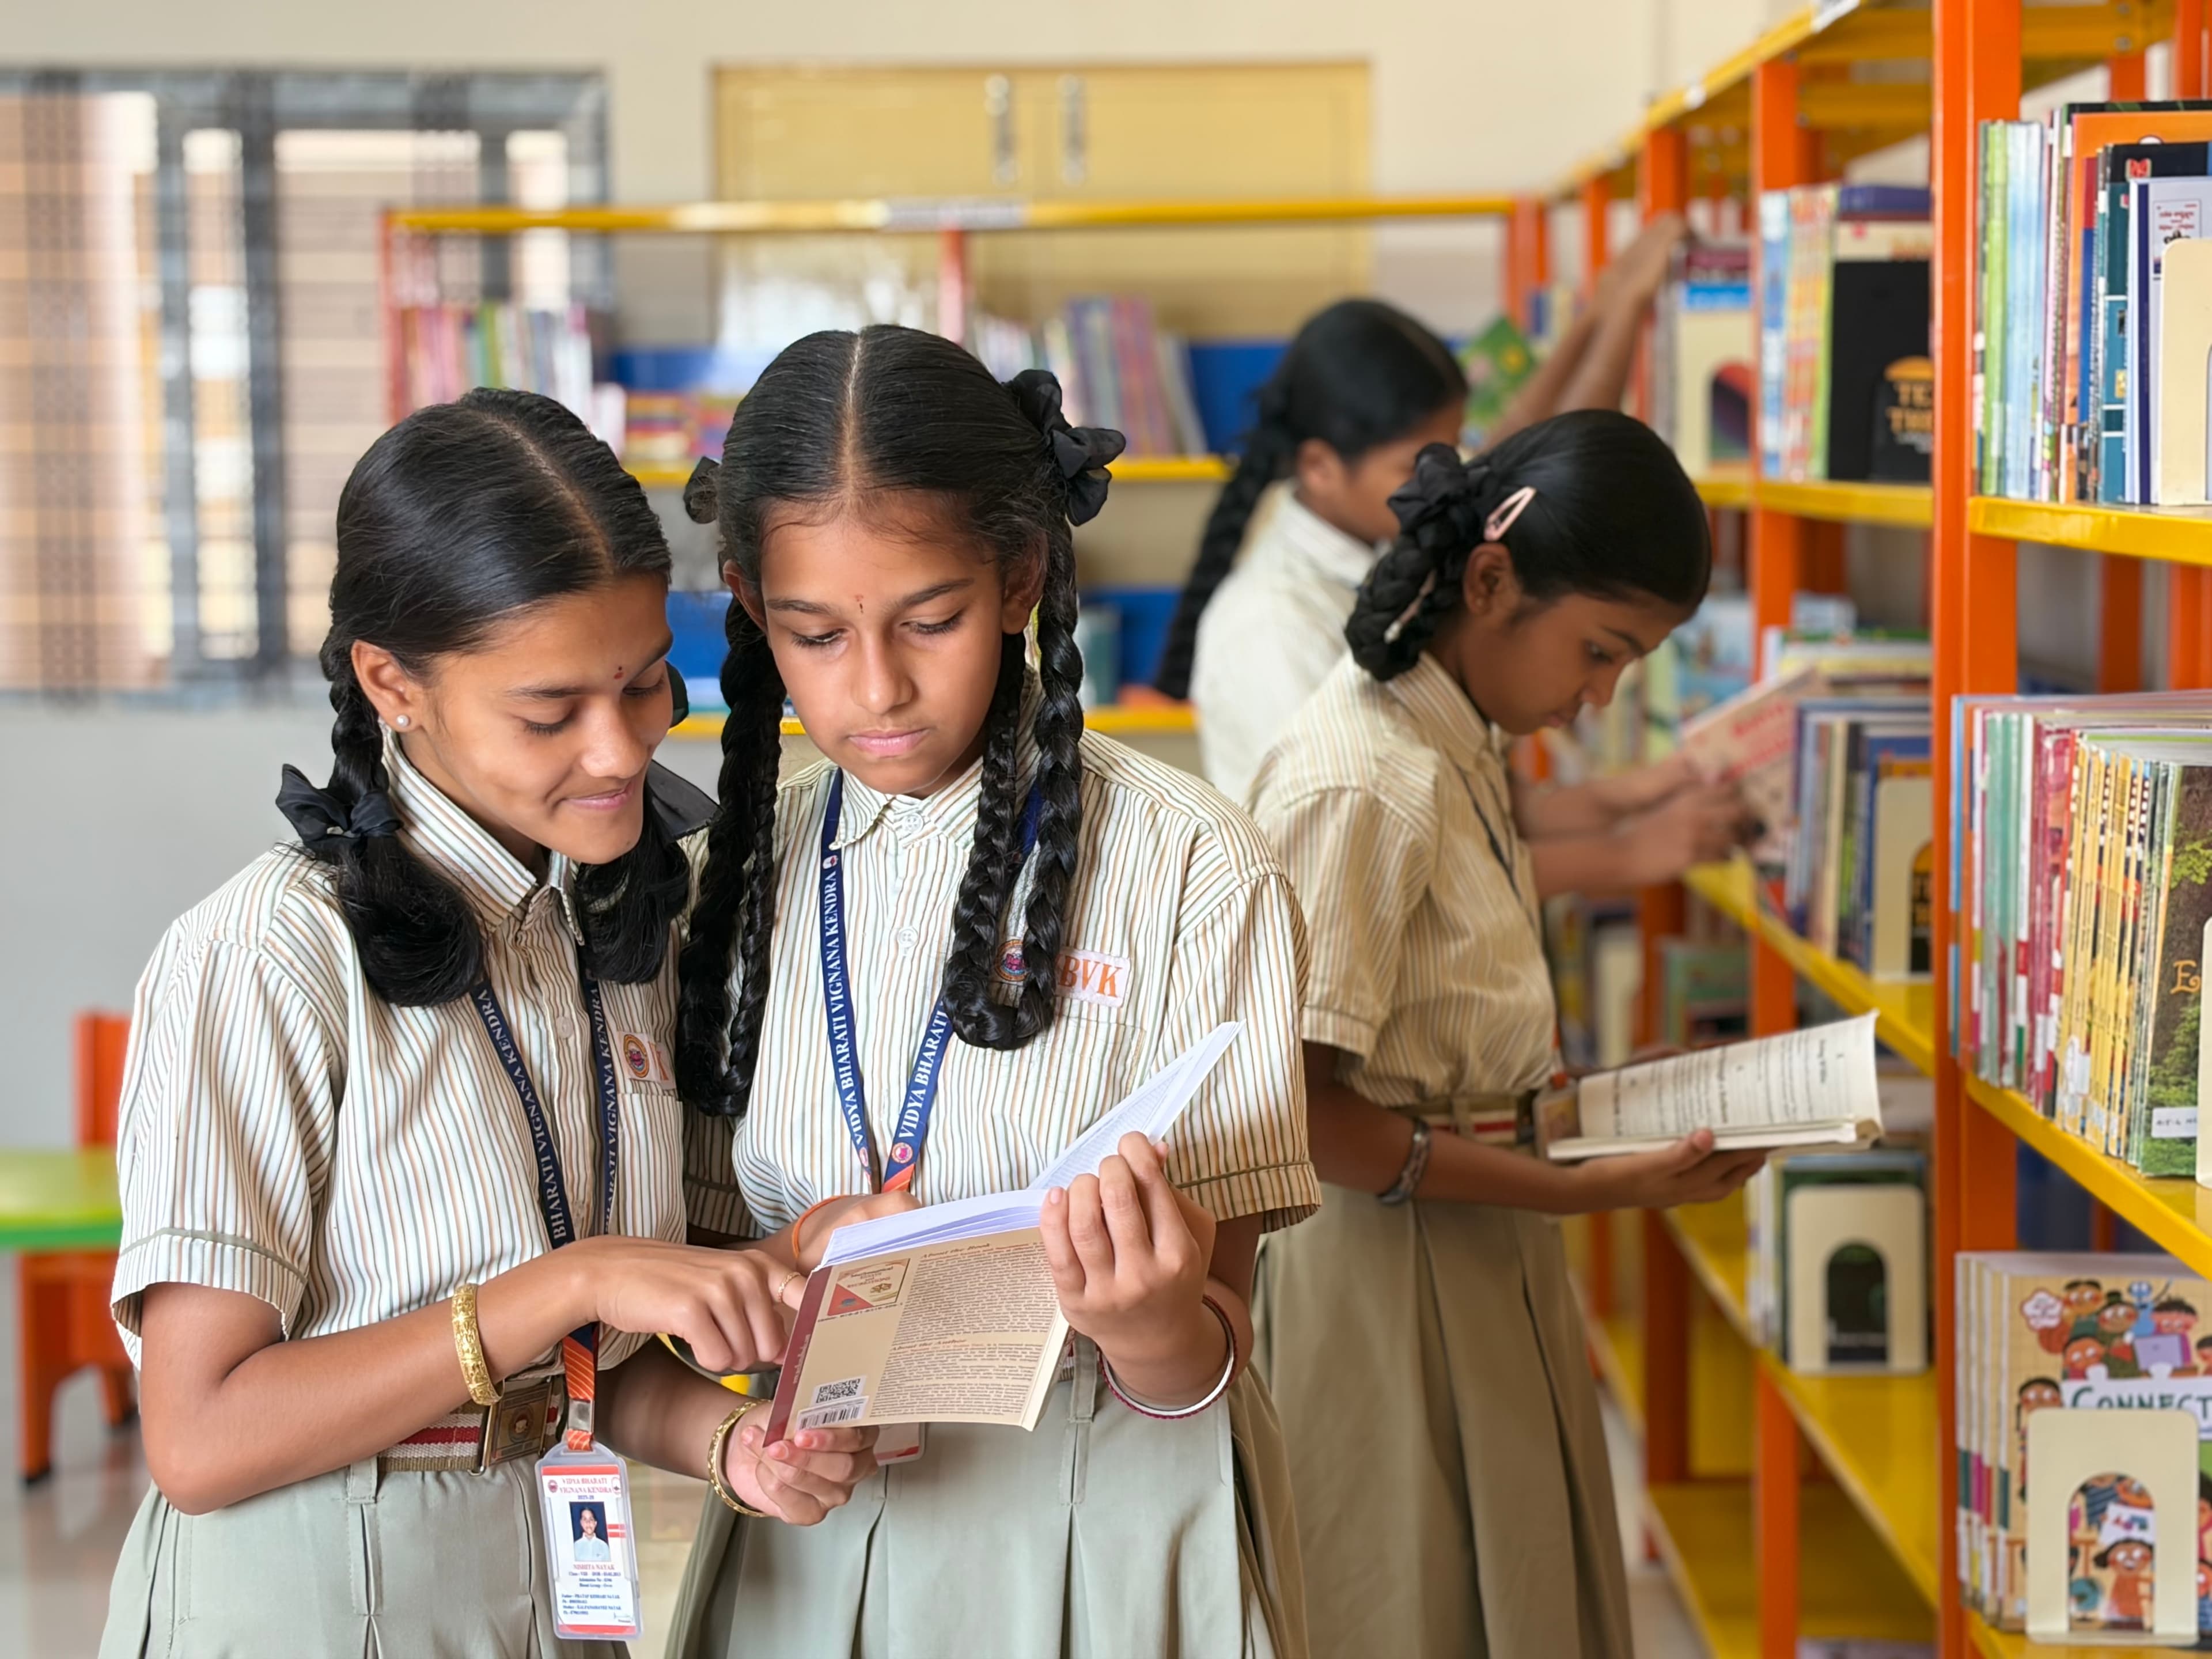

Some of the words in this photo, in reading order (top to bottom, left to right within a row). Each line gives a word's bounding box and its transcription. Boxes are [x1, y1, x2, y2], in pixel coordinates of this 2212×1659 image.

[824, 870, 839, 937] KENDRA
[826, 937, 844, 1014] VIGNANA
[478, 989, 517, 1065] KENDRA
[590, 988, 611, 1058] KENDRA
[832, 1014, 854, 1090] BHARATI
[514, 1066, 547, 1153] VIGNANA
[604, 1063, 618, 1145] VIGNANA
[899, 1089, 926, 1138] VIDYA
[914, 1010, 949, 1086] BHARATI
[845, 1090, 863, 1145] VIDYA
[540, 1154, 567, 1240] BHARATI
